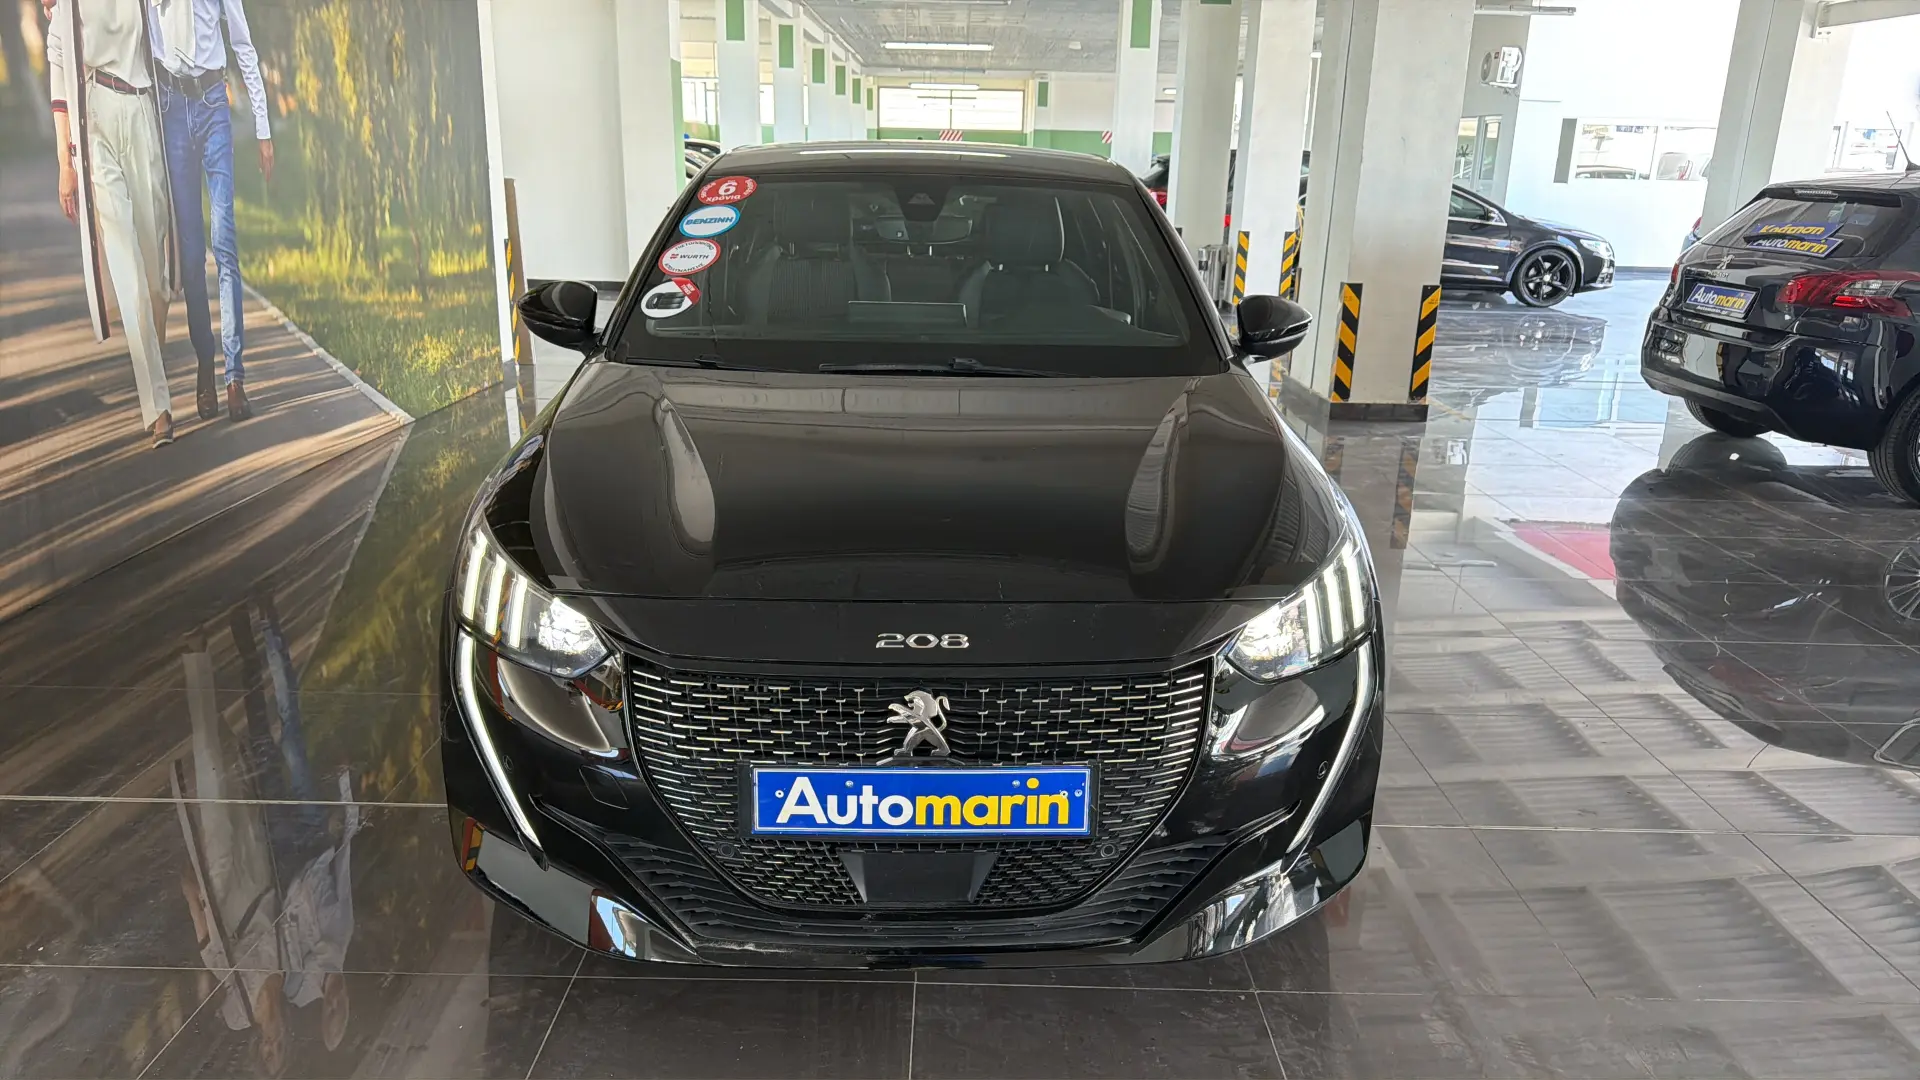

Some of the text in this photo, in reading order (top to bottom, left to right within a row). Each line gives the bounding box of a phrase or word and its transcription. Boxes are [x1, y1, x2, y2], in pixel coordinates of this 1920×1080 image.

[718, 182, 738, 196] 6
[1691, 286, 1746, 309] Automarin
[876, 633, 970, 649] 208
[776, 776, 1069, 826] Automarin
